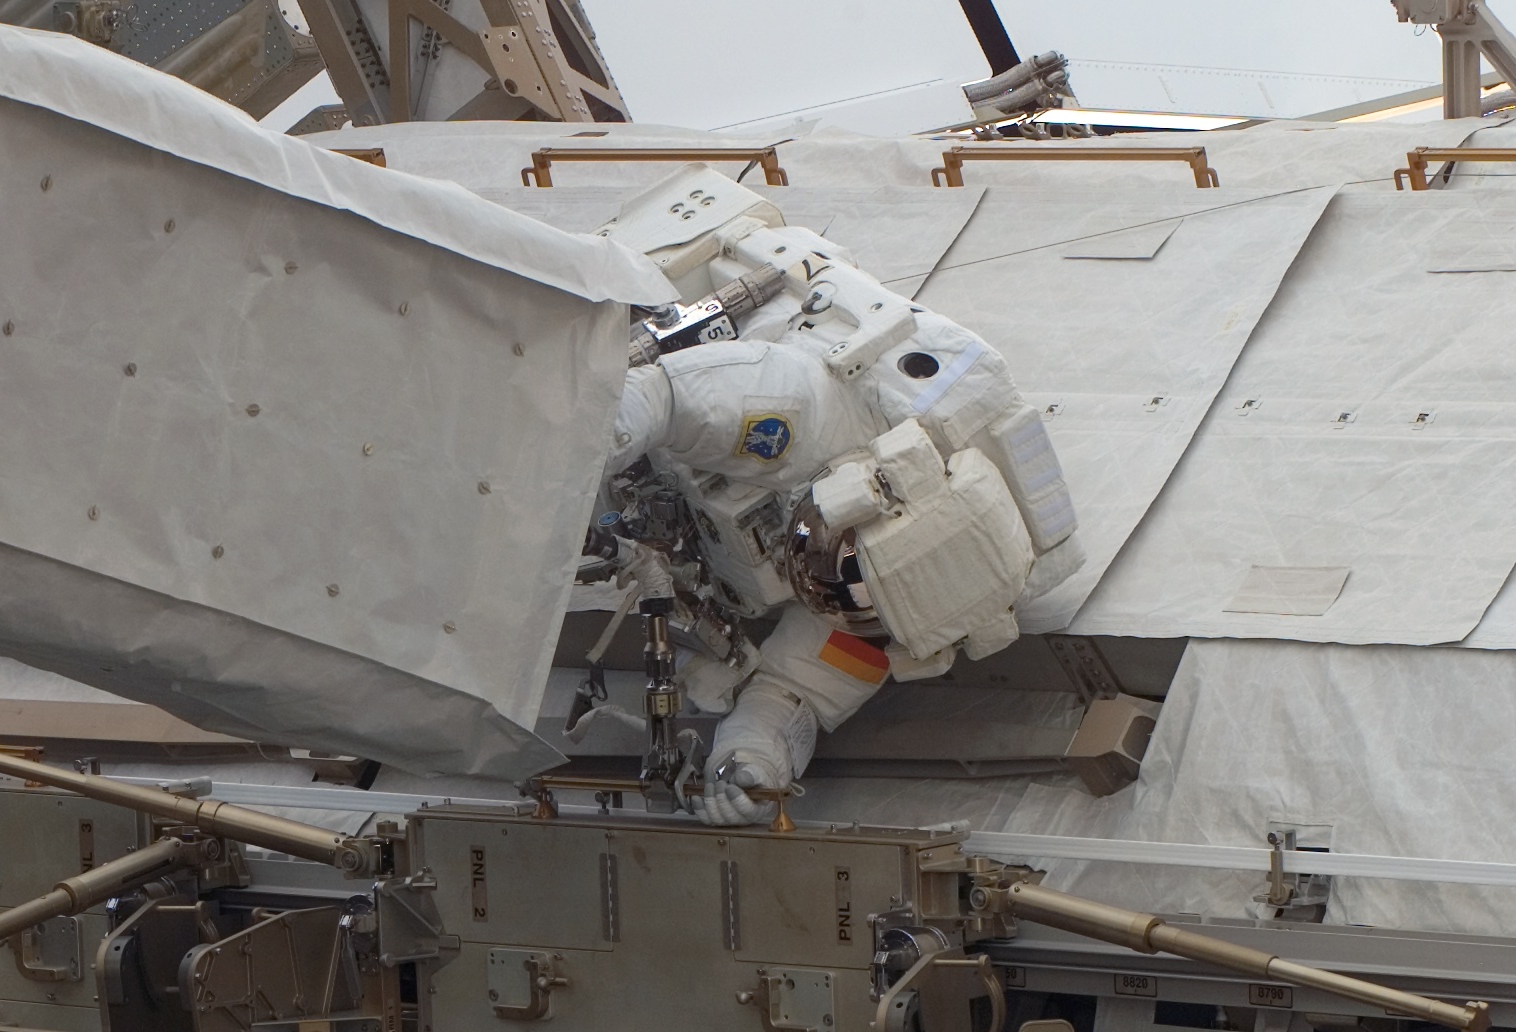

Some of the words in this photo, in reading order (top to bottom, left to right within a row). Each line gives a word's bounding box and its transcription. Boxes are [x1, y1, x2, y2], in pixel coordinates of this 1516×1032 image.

[707, 325, 724, 341] 5
[81, 821, 93, 834] 3
[472, 849, 484, 889] PNL
[837, 869, 849, 882] 3
[475, 906, 486, 919] 2
[838, 900, 851, 941] PNL
[1122, 975, 1148, 990] 8820
[1257, 986, 1284, 1002] 8790
